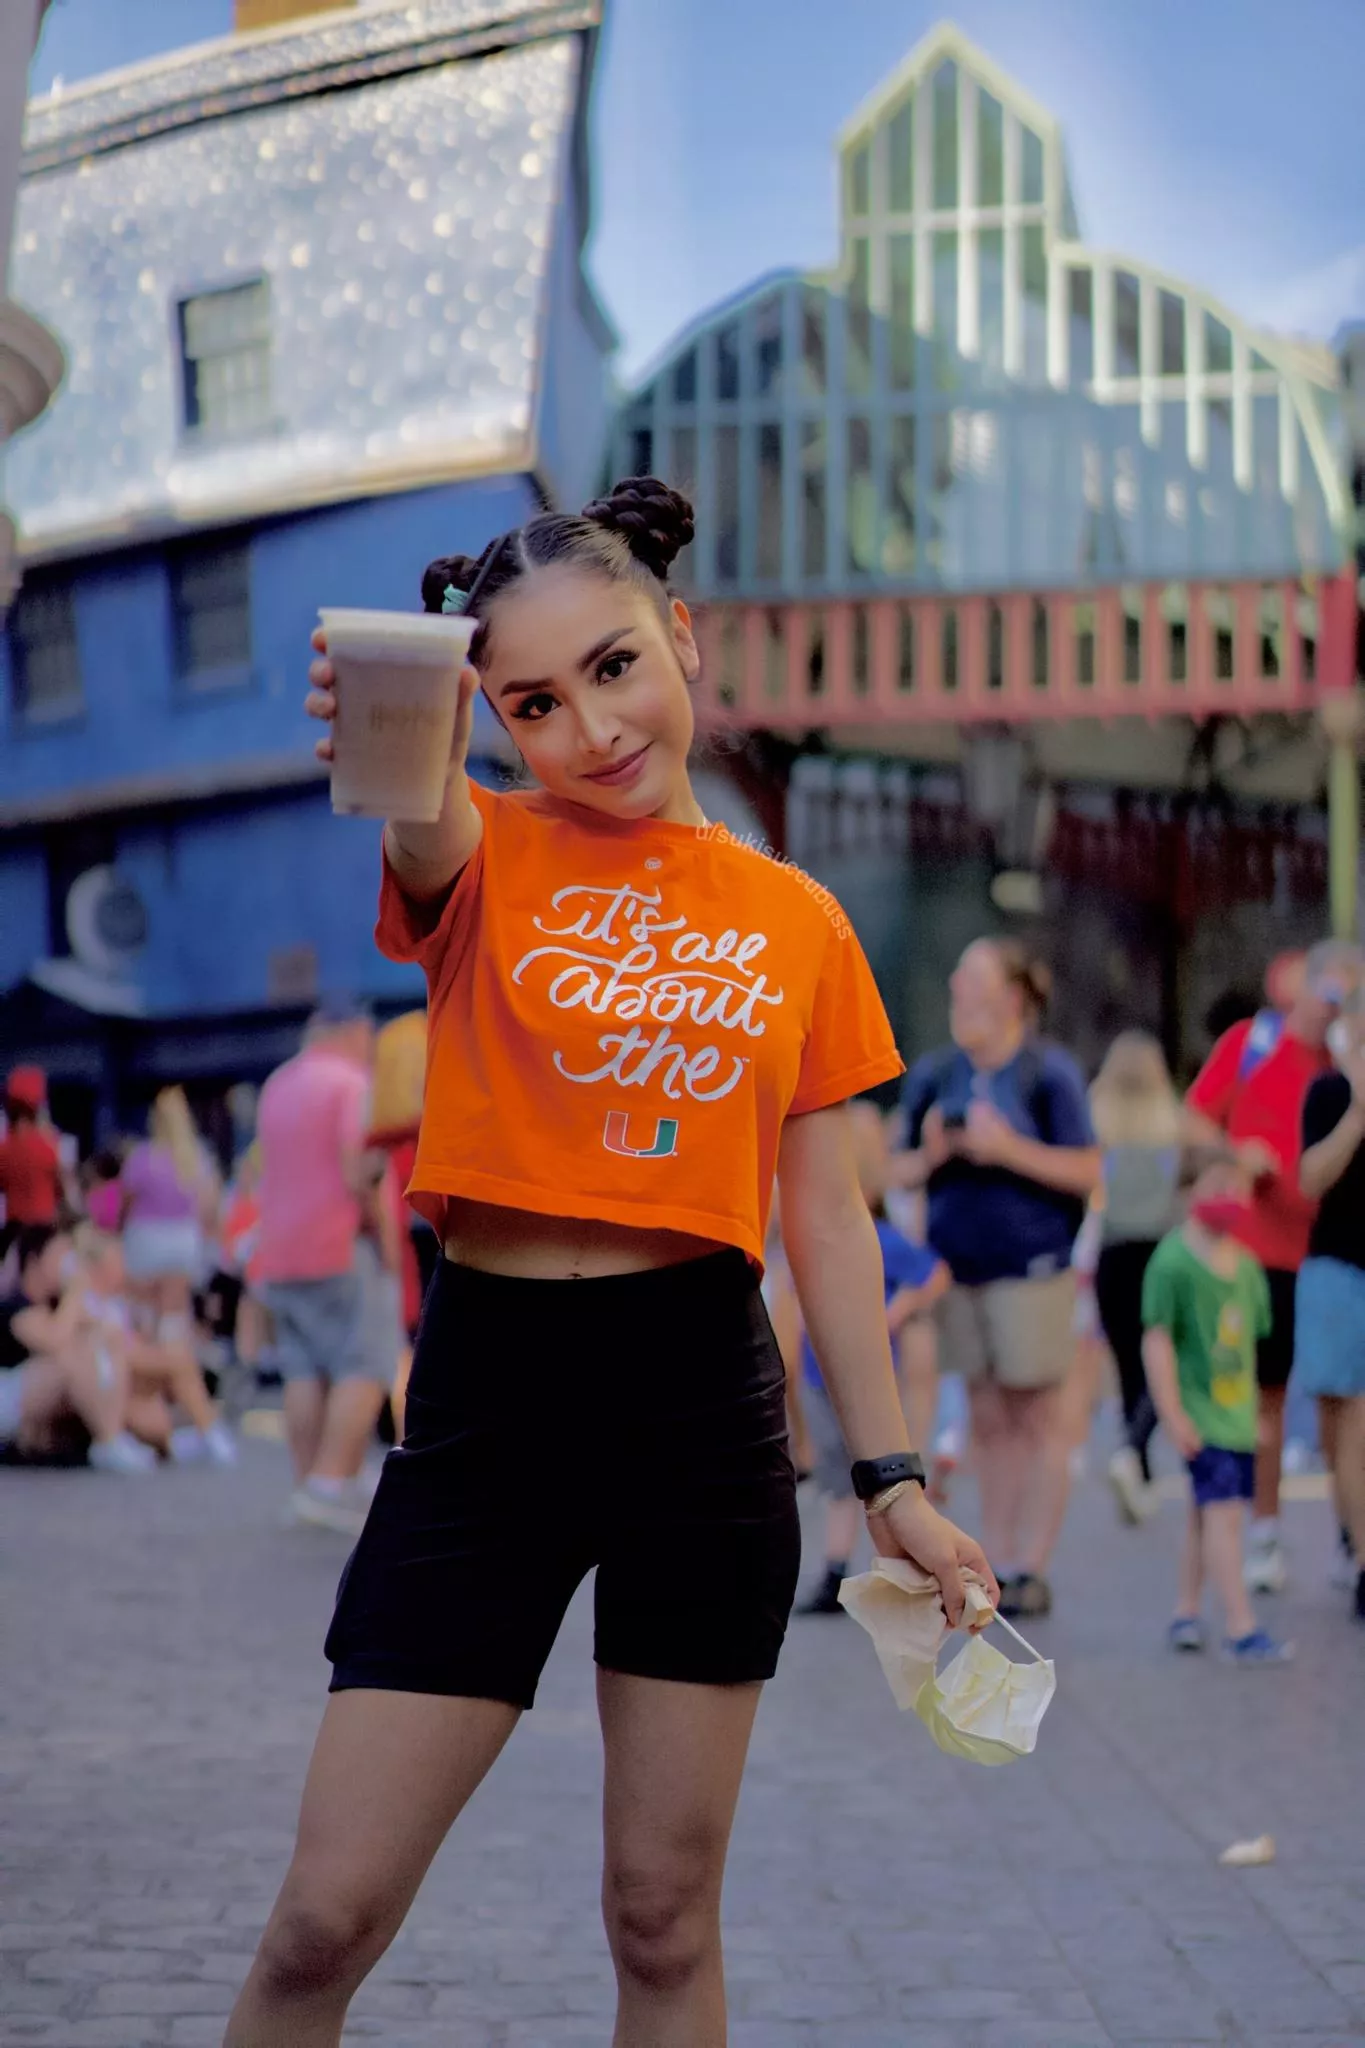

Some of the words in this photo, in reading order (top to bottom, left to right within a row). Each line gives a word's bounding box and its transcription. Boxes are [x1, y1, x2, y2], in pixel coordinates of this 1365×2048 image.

[532, 883, 687, 945] it's
[671, 929, 768, 978] all
[511, 942, 784, 1037] about
[553, 1024, 743, 1102] the
[602, 1110, 679, 1158] U
